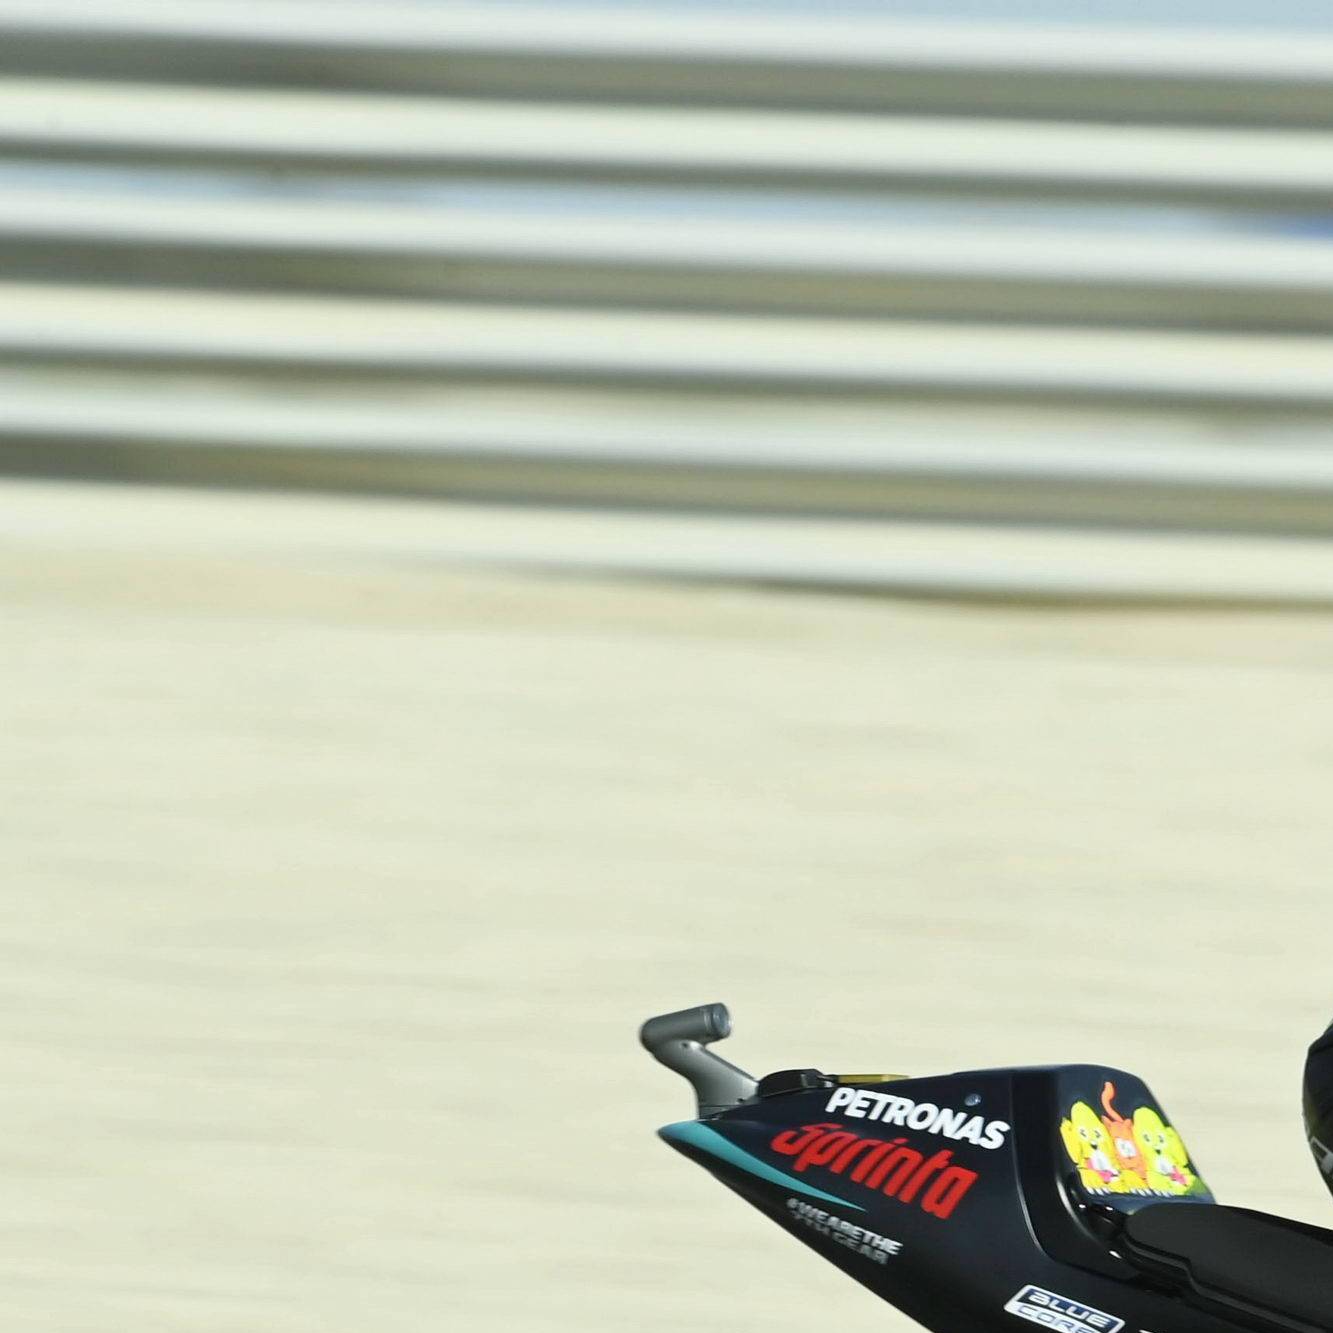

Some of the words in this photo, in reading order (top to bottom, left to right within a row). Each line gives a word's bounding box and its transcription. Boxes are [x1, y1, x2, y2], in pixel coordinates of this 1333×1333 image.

[825, 1087, 1011, 1150] PETRONAS
[770, 1122, 979, 1220] Sprinta
[1027, 1290, 1113, 1329] BLUE
